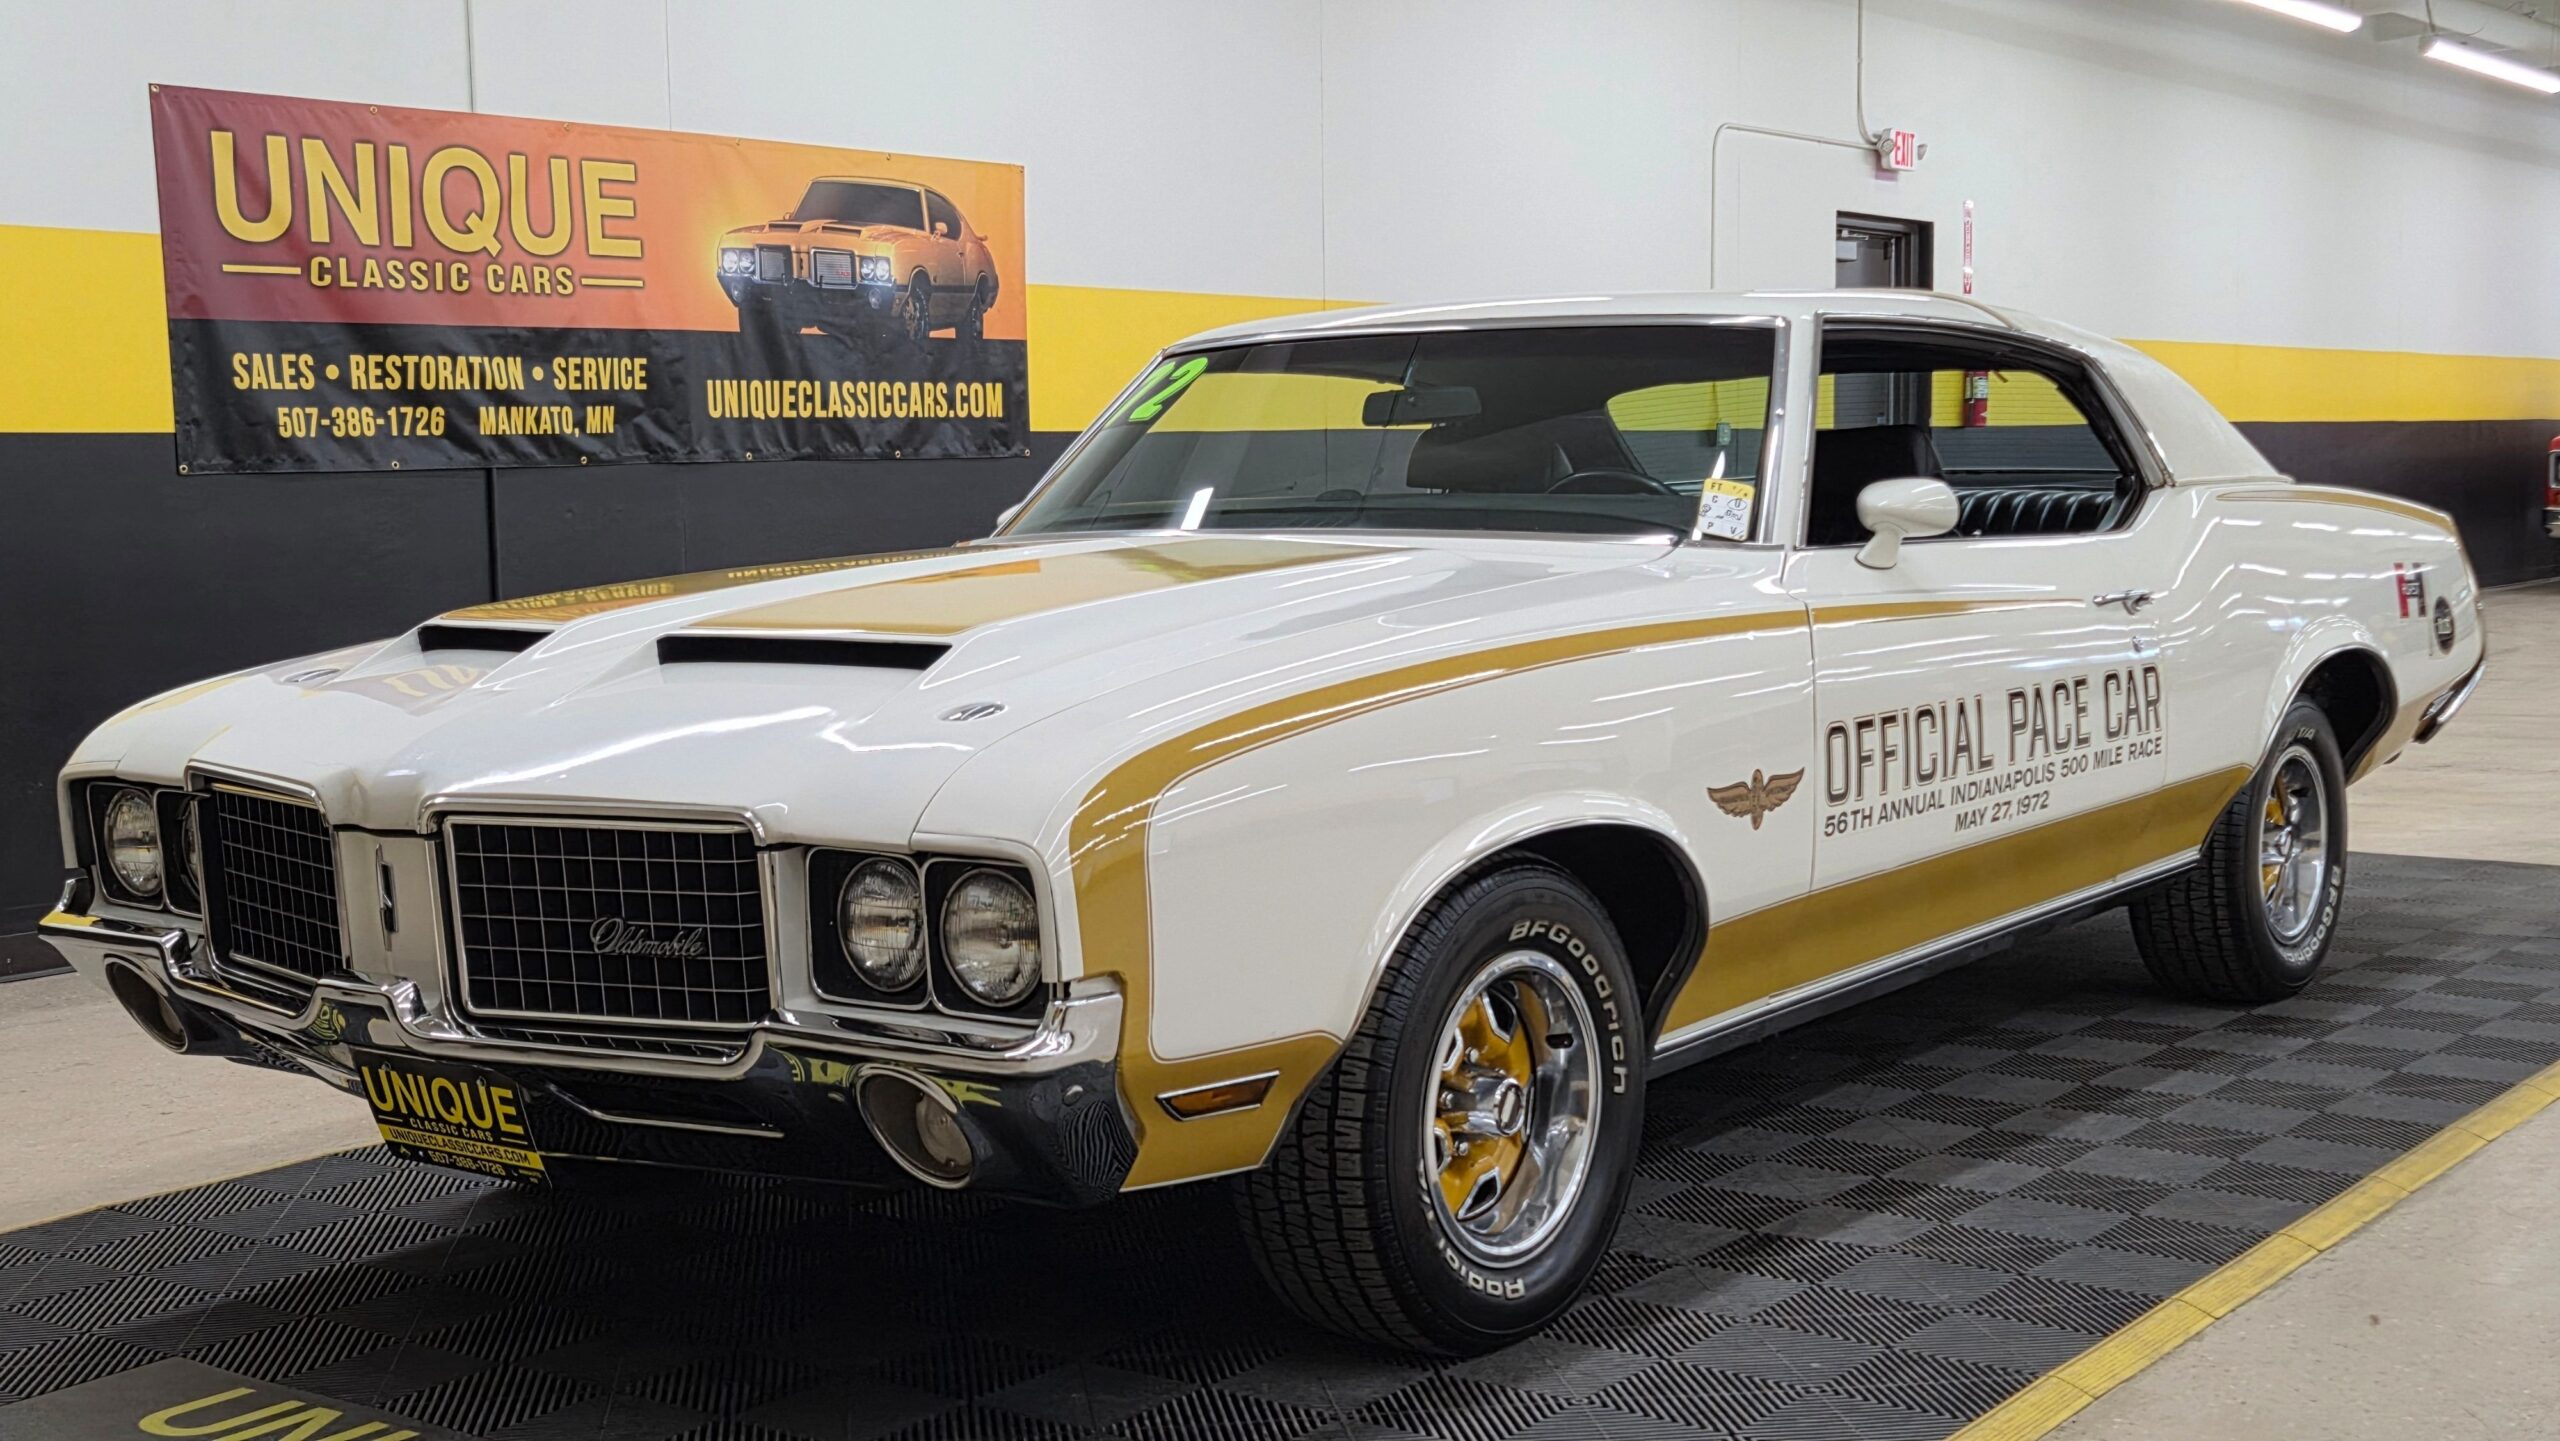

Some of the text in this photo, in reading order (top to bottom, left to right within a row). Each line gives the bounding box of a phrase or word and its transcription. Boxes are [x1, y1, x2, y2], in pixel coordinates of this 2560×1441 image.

[1894, 130, 1915, 167] EXIT
[210, 130, 643, 257] UNIQUE
[310, 256, 575, 295] CLASSIC CARS
[232, 352, 647, 391] SALES RESTORATION SERVICE
[706, 379, 1003, 420] UNIQUECLASSICCARS.COM
[277, 406, 615, 438] 507-386-1726 MANKATO, MN
[1824, 662, 2163, 807] OFFICIAL PACE CAR
[1824, 735, 2163, 838] 56TH ANNUAL INDIANAPOLIS 500 MILE RACE
[1954, 805, 1988, 833] MAY
[590, 917, 703, 956] Oldsmobile
[361, 1066, 525, 1135] UNIQUE
[389, 1126, 532, 1166] UNIQUECLASSICCARS.COM
[409, 1117, 494, 1142] CLASSIC CARS
